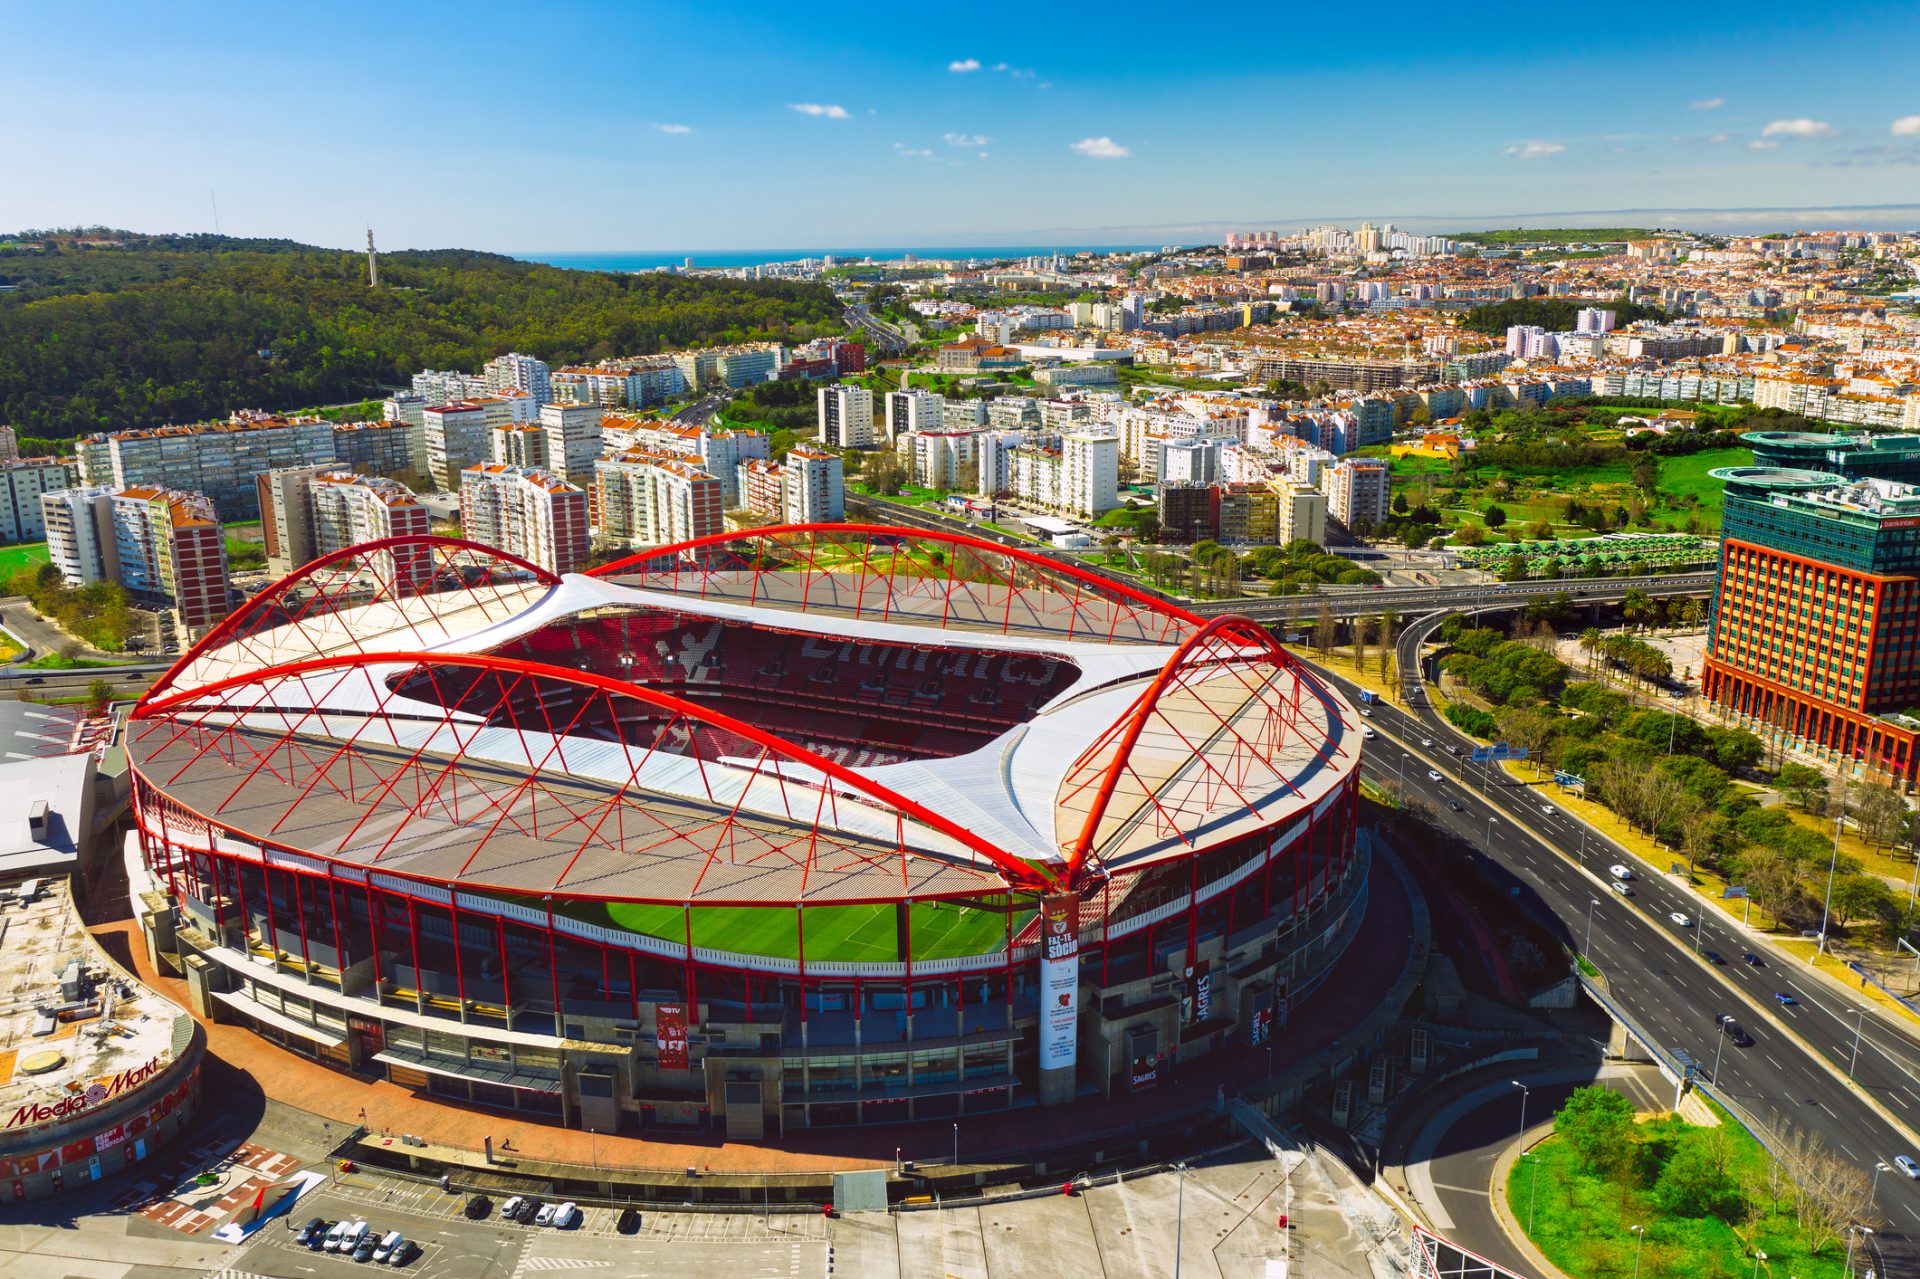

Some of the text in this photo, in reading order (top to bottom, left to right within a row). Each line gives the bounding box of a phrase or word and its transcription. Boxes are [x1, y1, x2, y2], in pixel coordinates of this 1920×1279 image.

[1048, 932, 1072, 946] FAZ-TE
[1132, 1070, 1157, 1085] SAGRES
[6, 1092, 86, 1129] Media
[104, 1056, 158, 1099] Markt
[95, 1127, 117, 1142] READY
[96, 1138, 109, 1147] FOR
[96, 1135, 125, 1153] BENFICA
